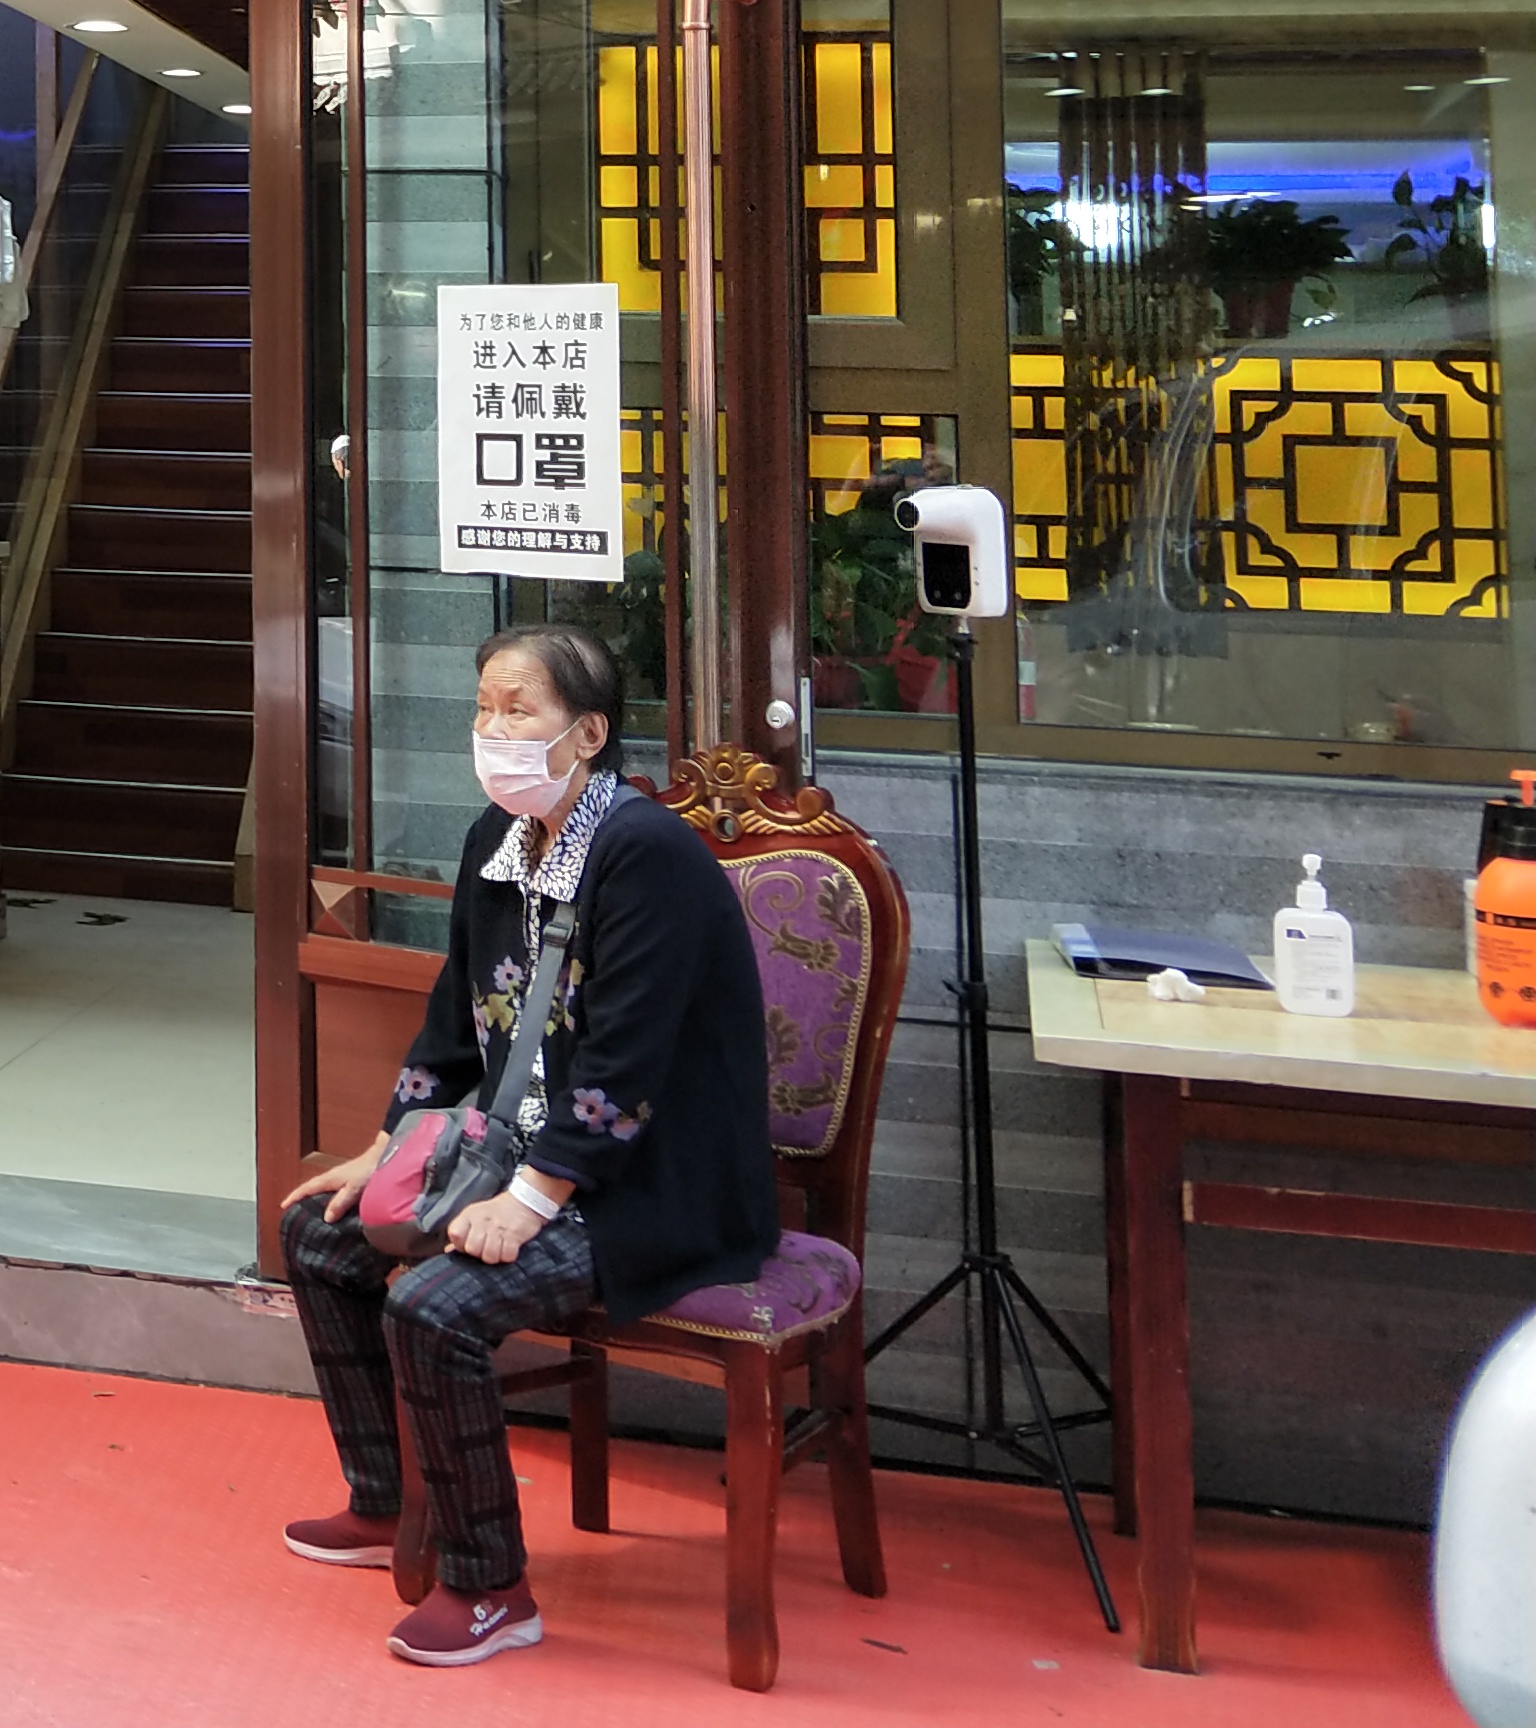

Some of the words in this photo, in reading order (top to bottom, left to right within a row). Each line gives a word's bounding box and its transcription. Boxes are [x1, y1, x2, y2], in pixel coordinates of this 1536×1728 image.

[459, 312, 604, 331] 为了您和他人的健康
[472, 339, 588, 370] 进入本店
[472, 382, 588, 420] 请佩戴
[475, 432, 587, 490] 口罩
[480, 500, 583, 524] 本店已消毒
[460, 528, 601, 551] 感谢您的理解与支持
